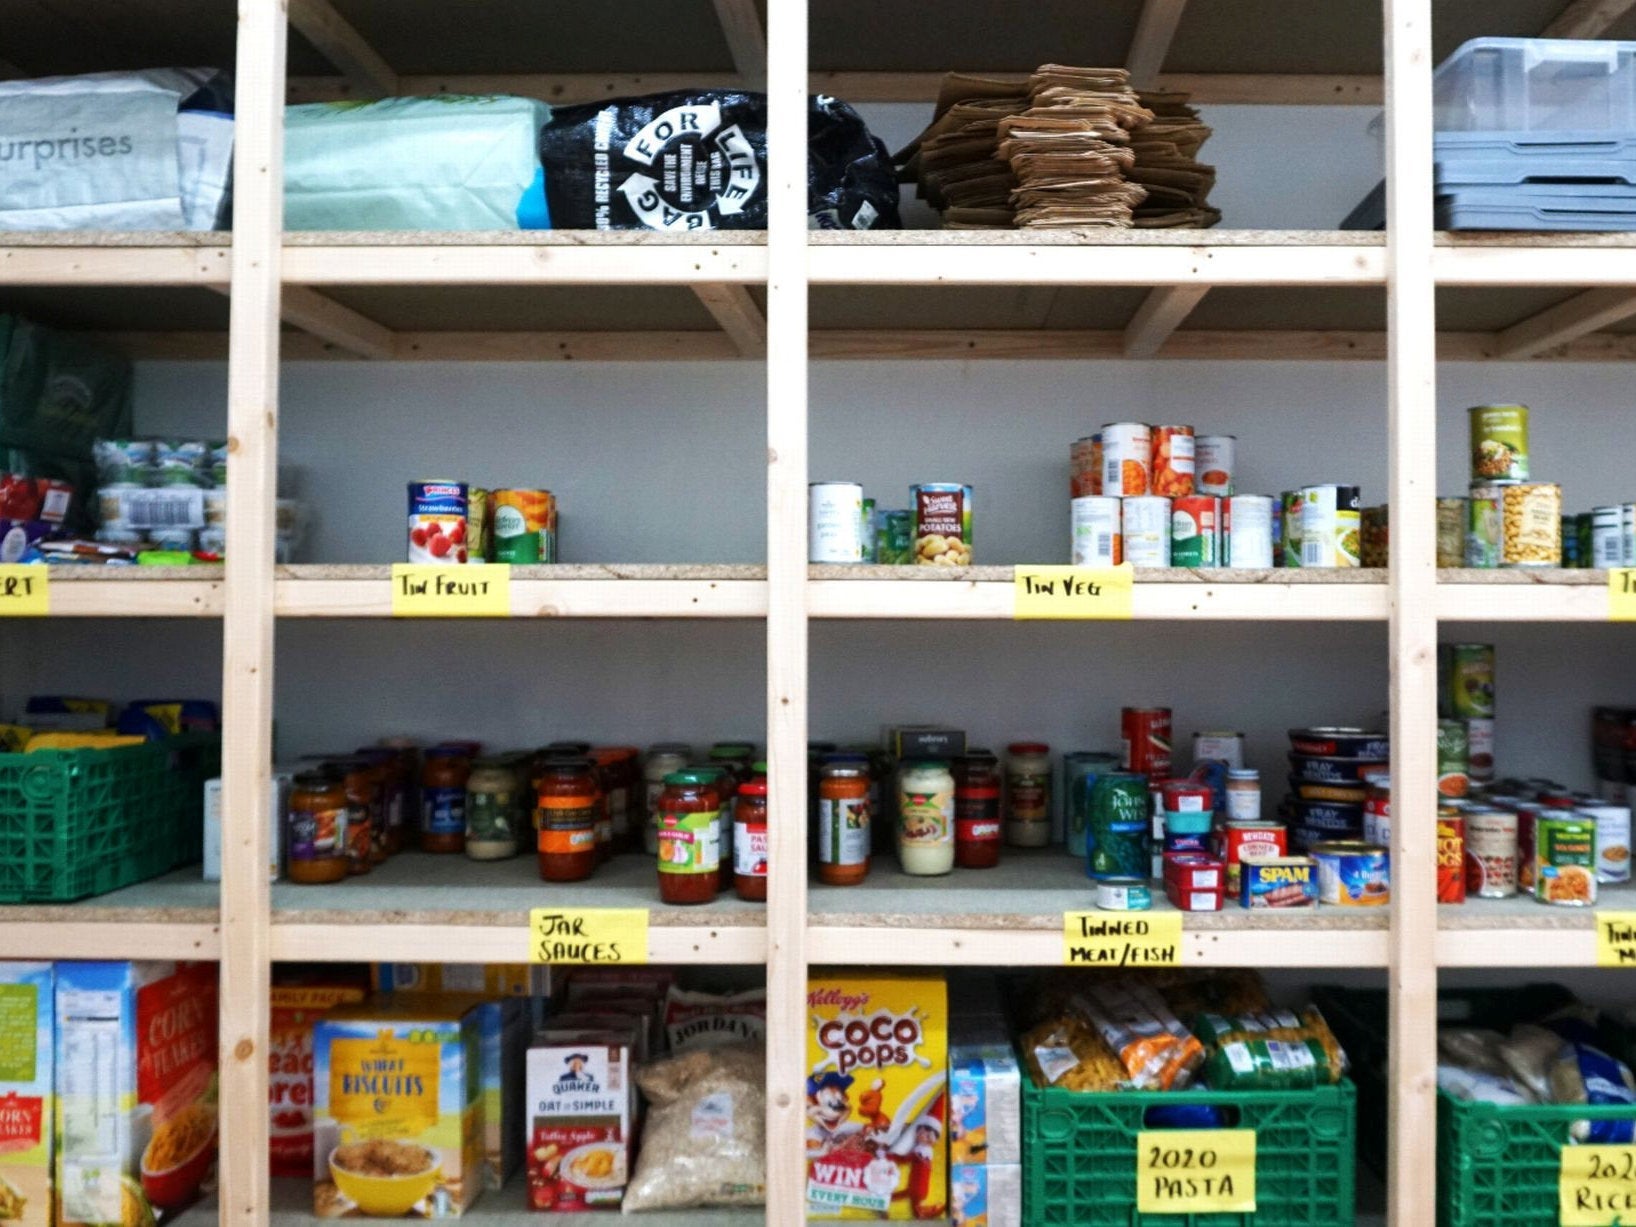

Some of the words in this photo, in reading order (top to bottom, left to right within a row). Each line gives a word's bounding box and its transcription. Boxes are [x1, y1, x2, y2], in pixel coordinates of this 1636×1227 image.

[635, 111, 701, 159] FOR
[663, 154, 677, 169] THE
[679, 143, 693, 203] ENVIRONMENT
[717, 129, 754, 201] LIFE
[663, 171, 677, 192] SAVE
[709, 171, 721, 191] THIS
[636, 189, 703, 230] BAG
[919, 523, 962, 532] POTATOES
[0, 575, 35, 597] RT
[436, 574, 491, 597] FRUIT
[1063, 575, 1102, 596] VEG
[1259, 866, 1311, 883] SPAM
[539, 914, 589, 937] JAR
[538, 940, 622, 963] SAUCES
[1070, 943, 1175, 967] MEAT/FISH
[148, 995, 205, 1049] CORN
[343, 1073, 424, 1097] BISCUITS
[553, 1081, 601, 1095] QUAKER
[538, 1101, 562, 1112] OAT
[572, 1100, 616, 1111] SIMPLE
[1148, 1145, 1218, 1169] 2020
[1588, 1152, 1636, 1180] 202
[813, 1161, 864, 1188] WIN
[810, 1188, 848, 1202] EVERY
[1155, 1174, 1234, 1199] PASTA
